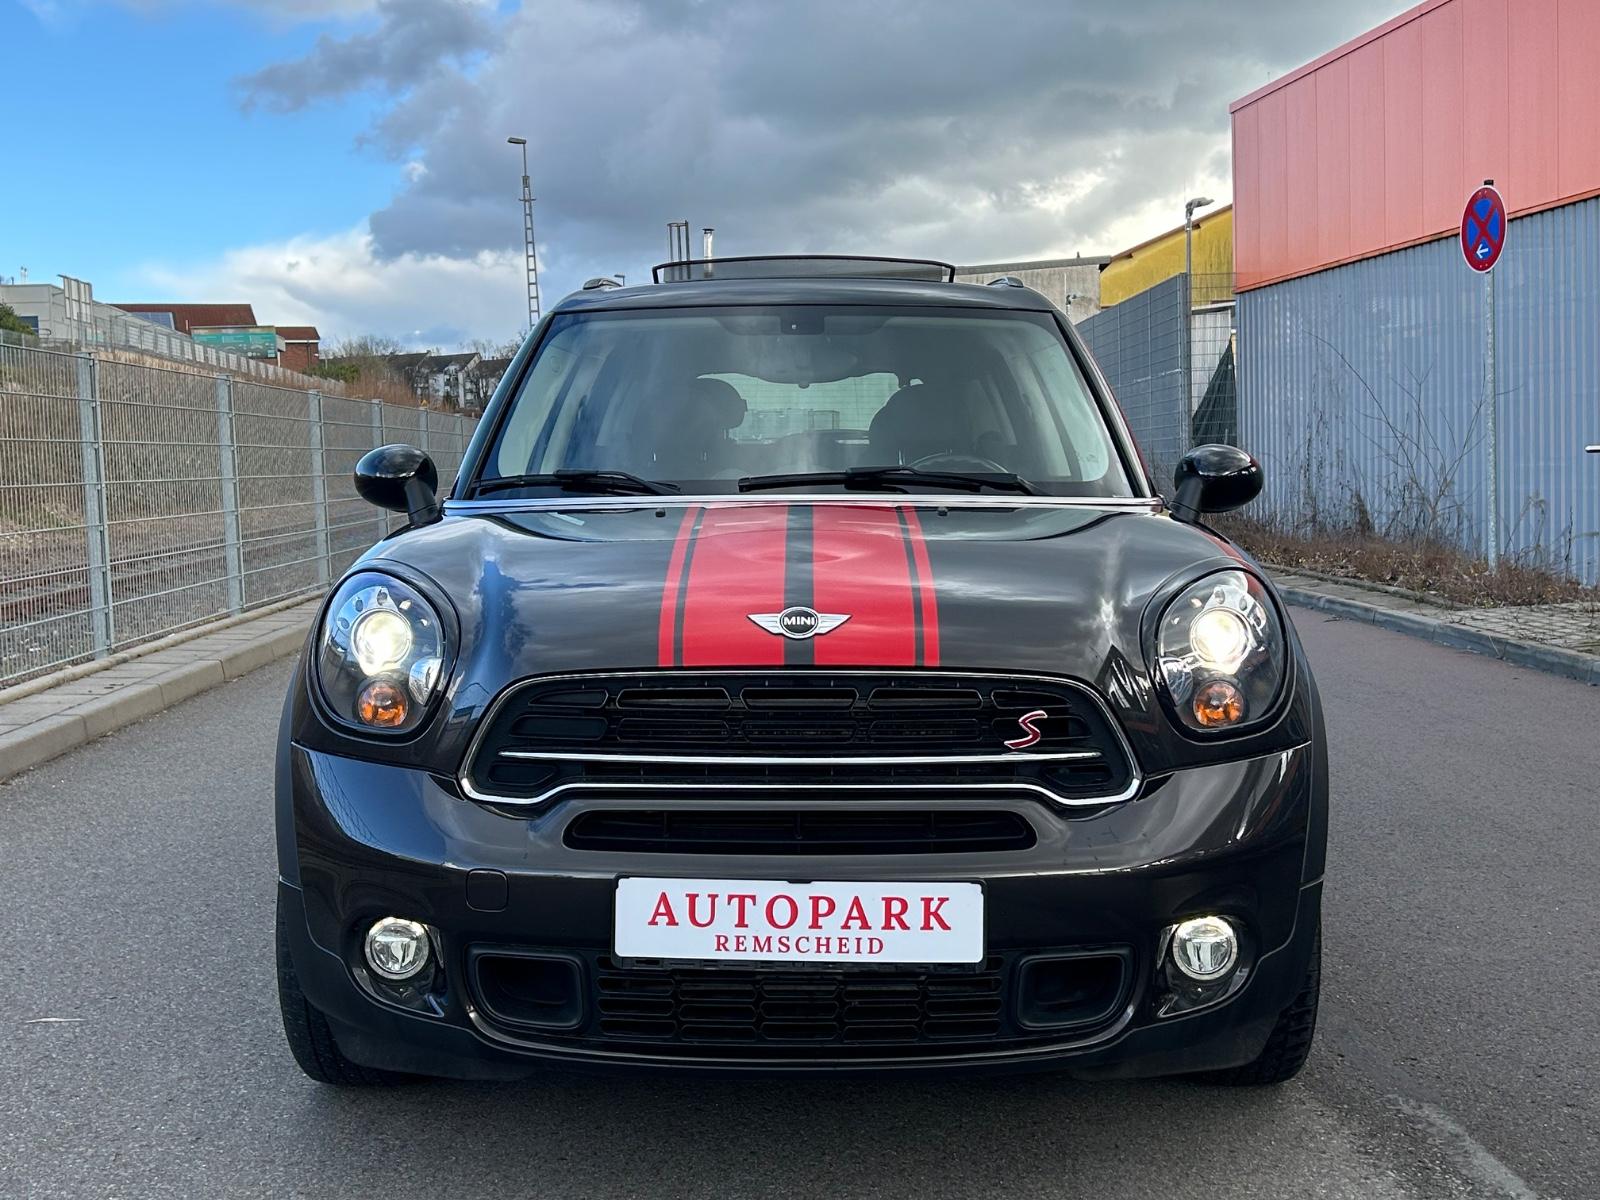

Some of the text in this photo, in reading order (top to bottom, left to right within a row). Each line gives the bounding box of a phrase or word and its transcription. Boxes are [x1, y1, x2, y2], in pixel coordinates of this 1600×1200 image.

[783, 616, 815, 626] MINI
[1003, 709, 1048, 749] S
[648, 891, 951, 931] AUTOPARK
[714, 934, 885, 954] REMSCHEID
